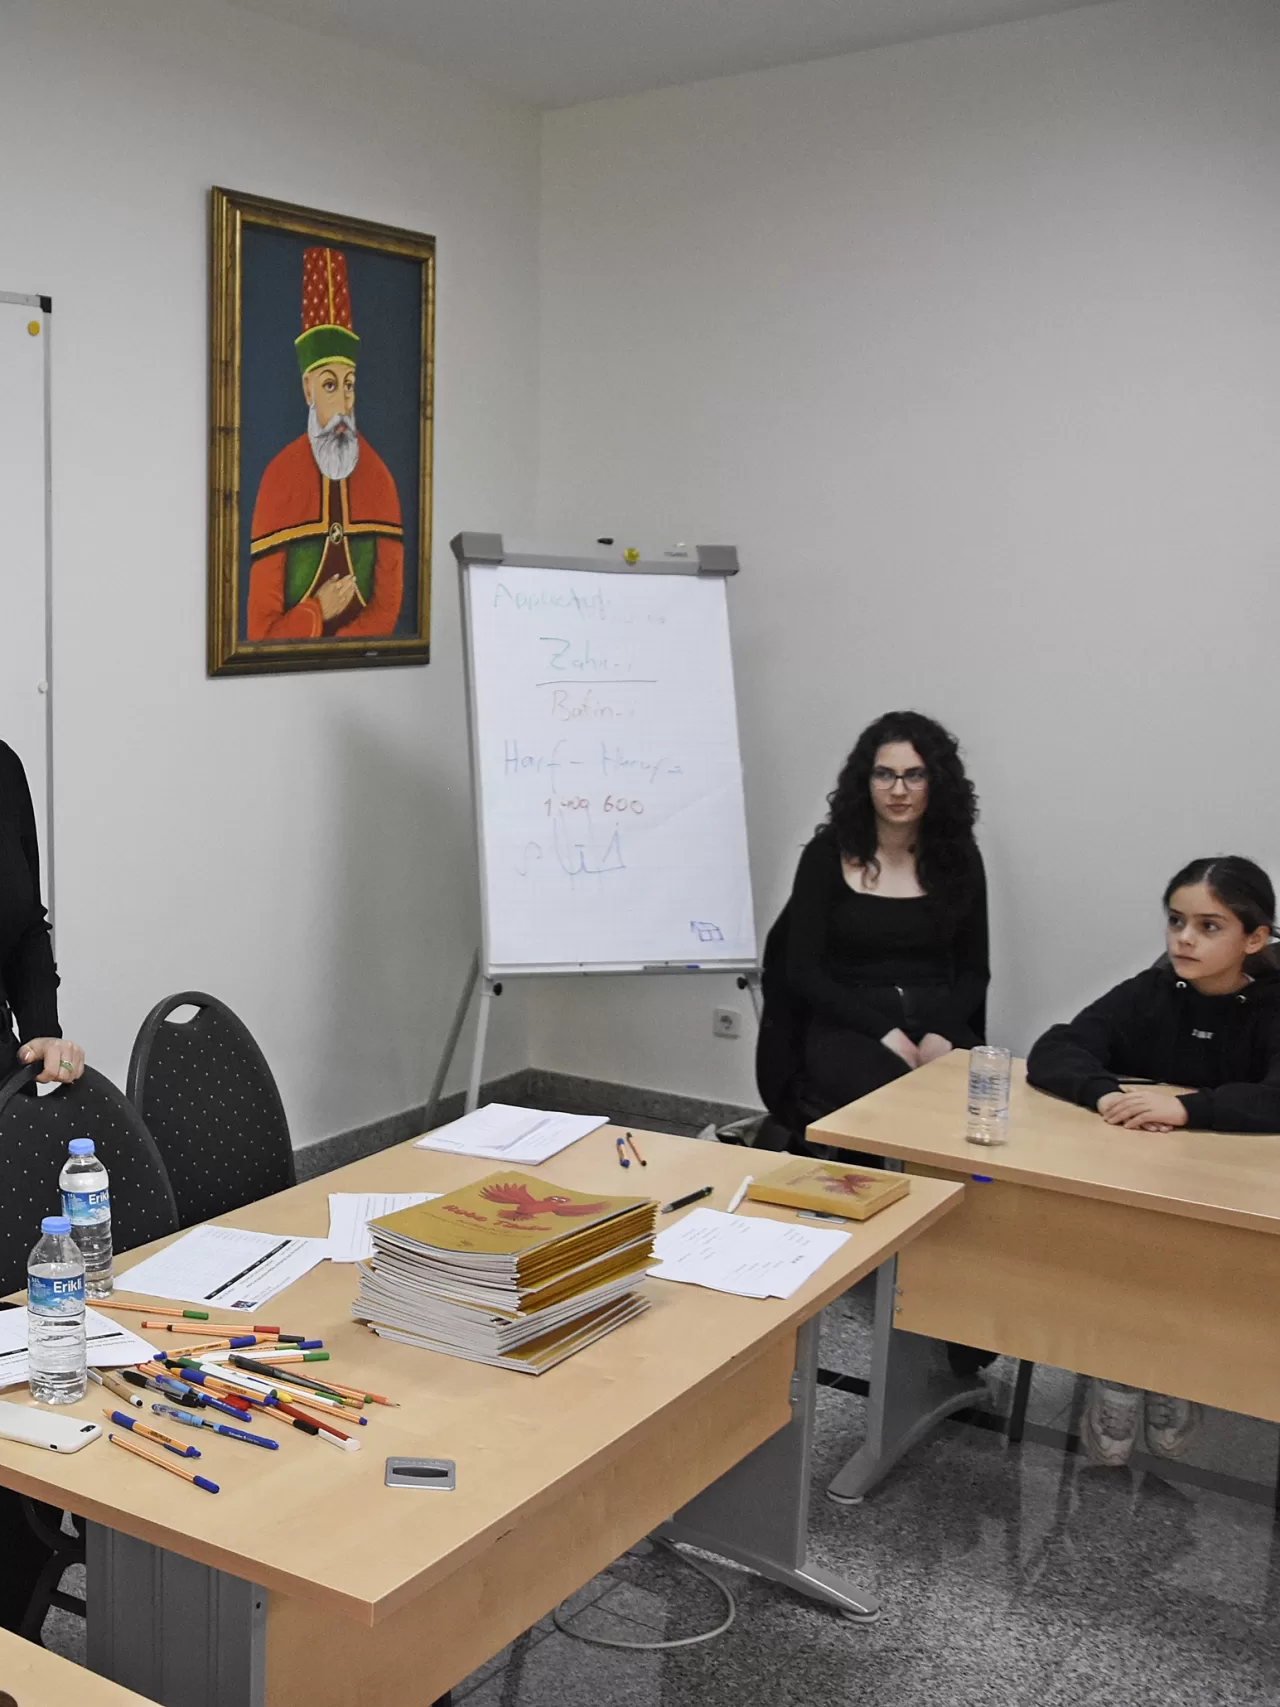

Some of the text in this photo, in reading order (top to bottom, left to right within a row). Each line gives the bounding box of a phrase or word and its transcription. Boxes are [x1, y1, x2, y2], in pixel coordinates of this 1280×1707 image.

[603, 795, 644, 814] 600
[88, 1191, 110, 1205] Erikl
[53, 1279, 82, 1293] Erikli
